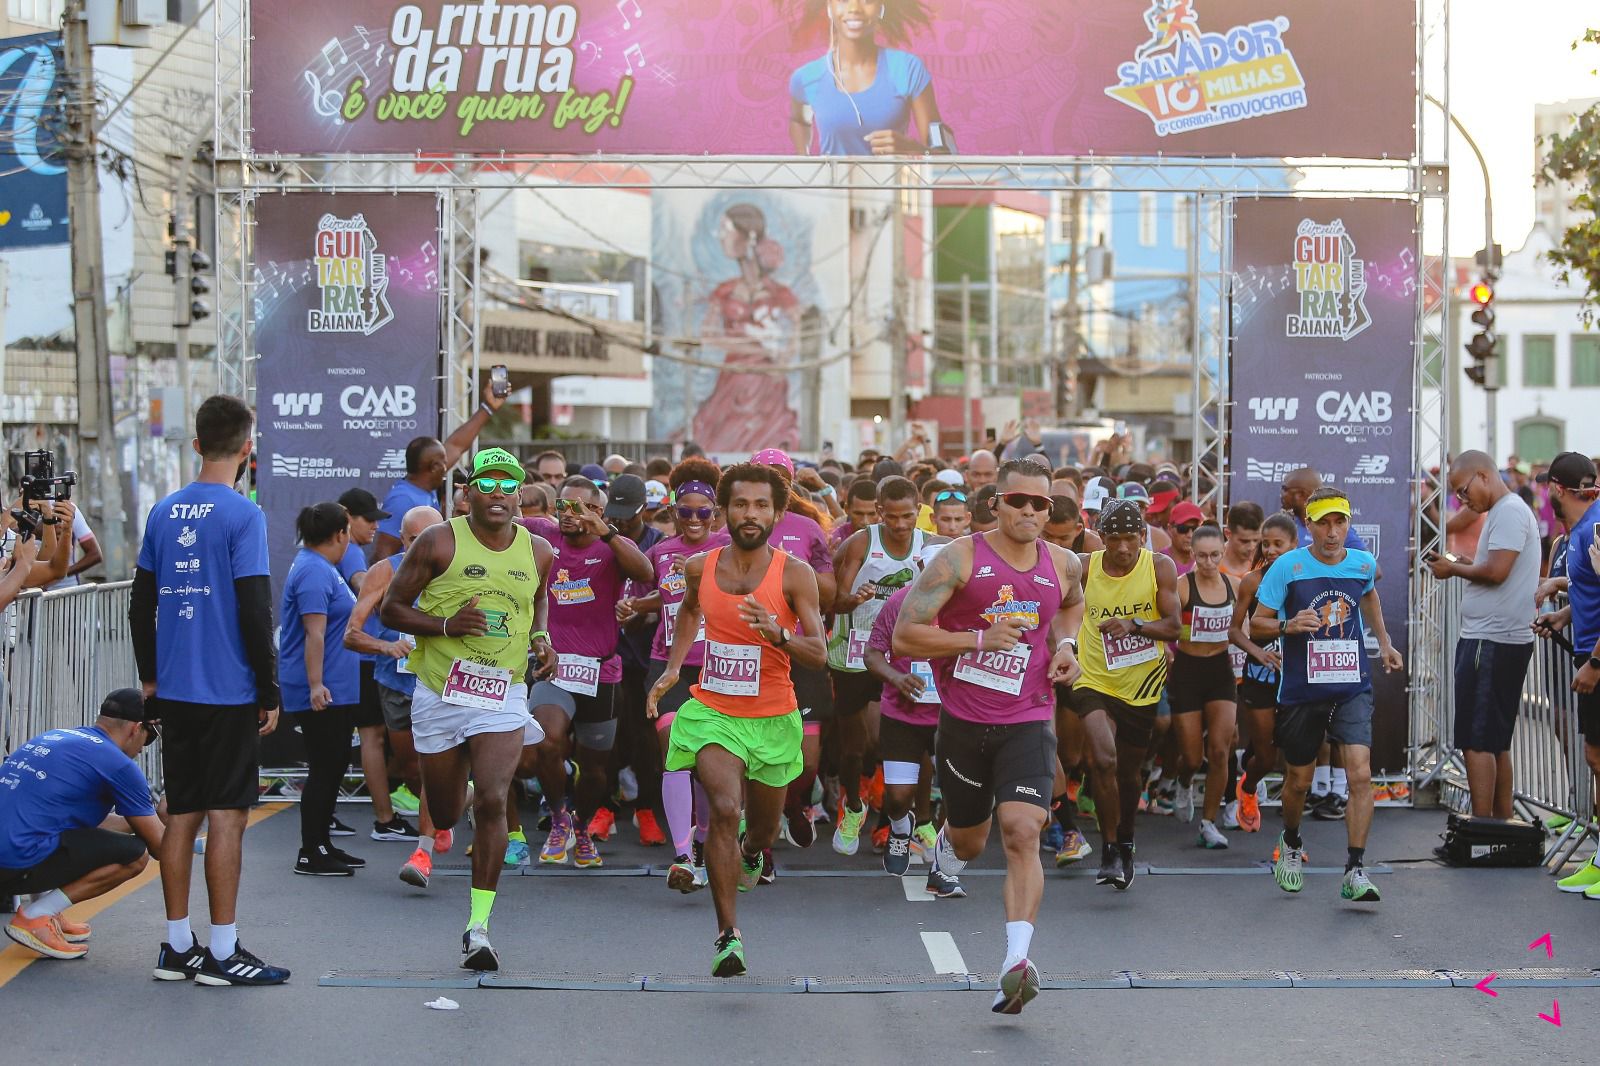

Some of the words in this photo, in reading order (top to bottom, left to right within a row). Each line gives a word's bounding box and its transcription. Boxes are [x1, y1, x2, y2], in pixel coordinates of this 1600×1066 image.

[391, 5, 422, 45] o
[438, 0, 576, 45] ritmo
[393, 30, 460, 92] da
[478, 47, 573, 92] rua
[1120, 23, 1282, 87] SALVADOR
[1154, 78, 1199, 115] 10
[1207, 64, 1286, 97] MILHAS
[344, 80, 364, 119] é
[377, 82, 446, 119] você
[457, 92, 544, 135] quem
[553, 78, 631, 132] faz!
[1170, 113, 1213, 131] CORRIDA
[1220, 91, 1303, 119] ADVOCACIA
[317, 231, 360, 258] GUI
[1296, 236, 1339, 263] GUI
[316, 258, 363, 286] TAR
[1295, 263, 1342, 291] TAR
[324, 286, 359, 313] RA
[1303, 291, 1337, 318] RA
[340, 385, 416, 417] CAAB
[1316, 390, 1392, 423] CAAB
[343, 419, 417, 432] novotempo
[1319, 424, 1392, 438] novotempo
[299, 467, 361, 479] Esportiva
[300, 457, 333, 467] Casa
[369, 471, 386, 479] new
[1362, 476, 1395, 485] balance
[170, 504, 214, 519] STAFF
[1100, 602, 1153, 618] AALFA
[1335, 590, 1357, 608] BOTELHO
[1203, 616, 1231, 629] 10512
[715, 657, 755, 676] 10719
[977, 651, 1023, 674] 12015
[1320, 653, 1355, 667] 11809
[562, 665, 594, 681] 10921
[462, 674, 505, 696] 10830
[1015, 785, 1042, 798] R2L
